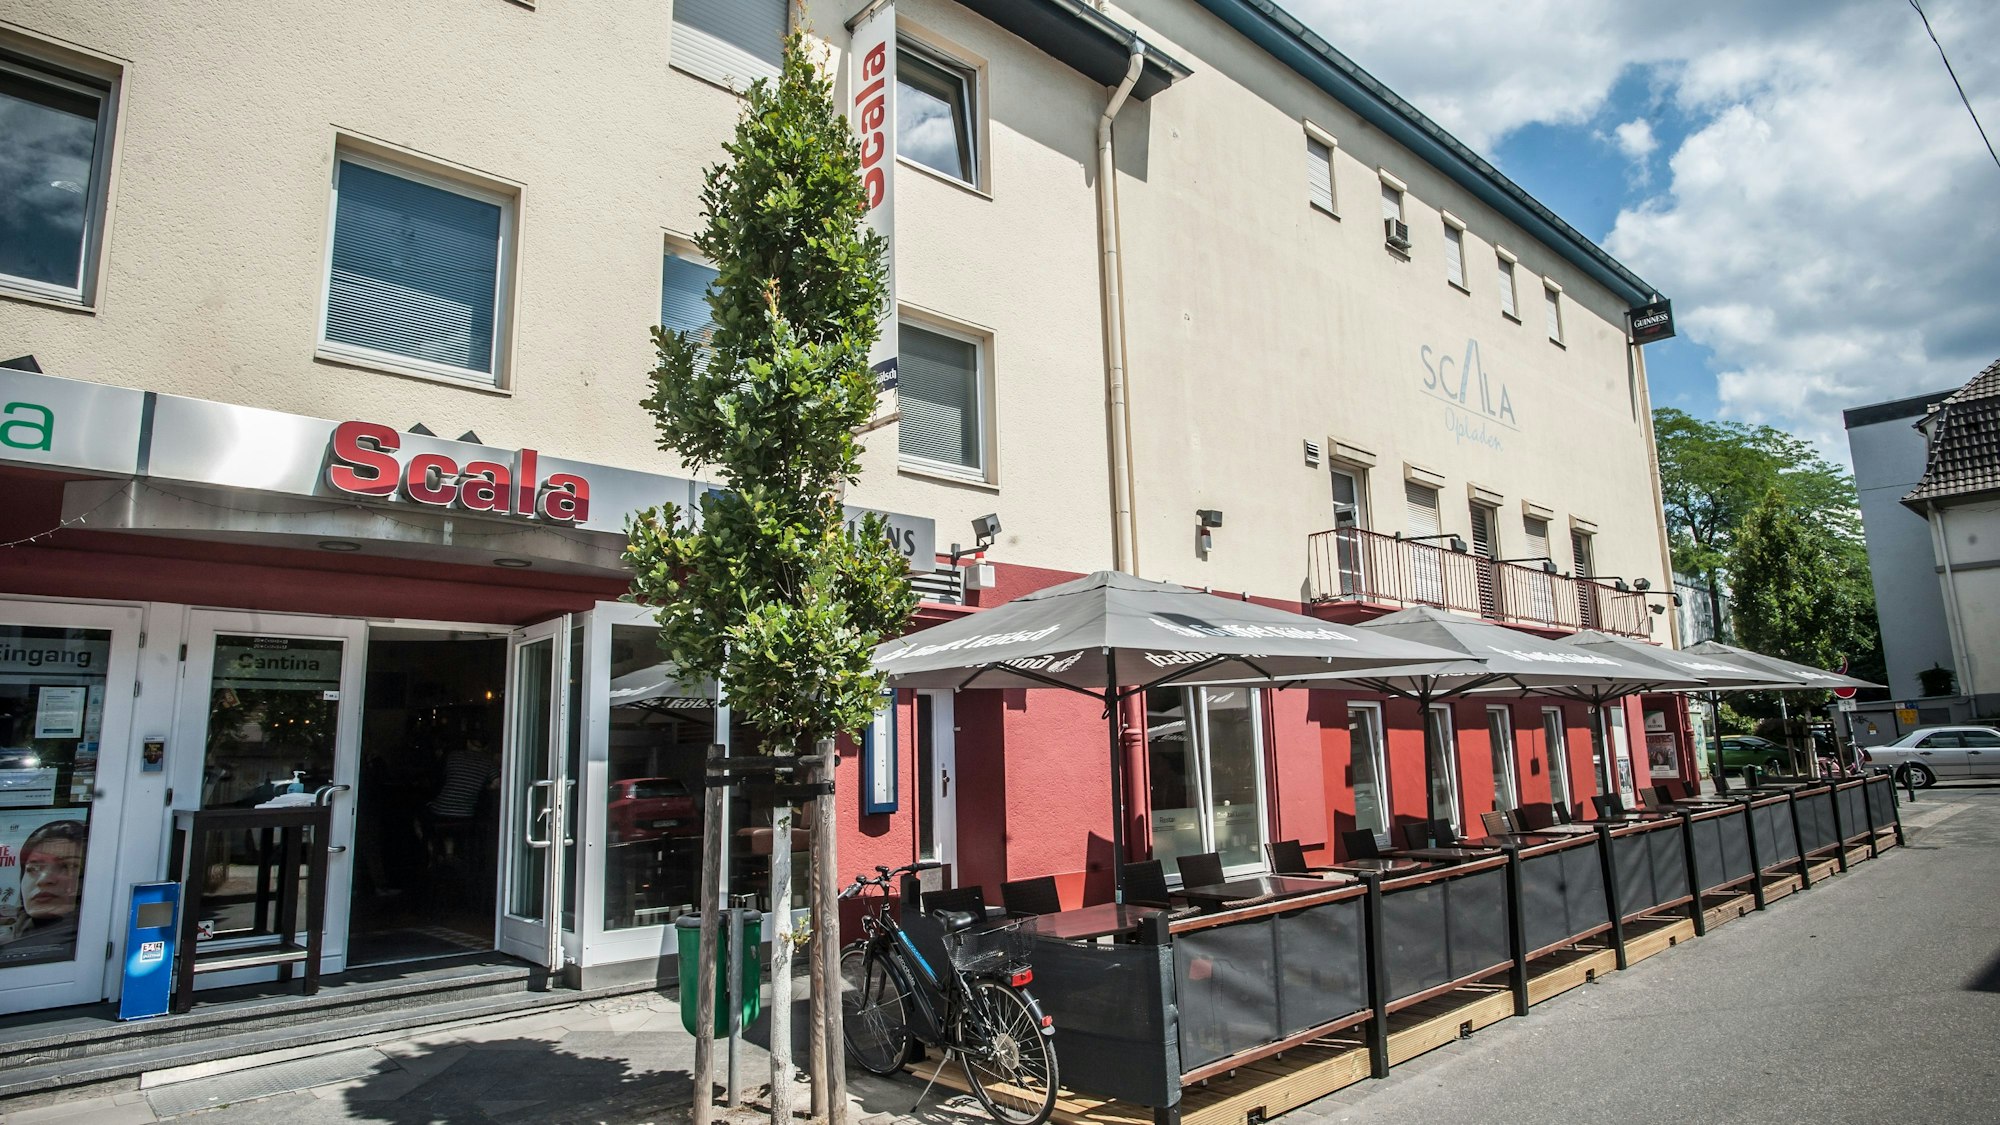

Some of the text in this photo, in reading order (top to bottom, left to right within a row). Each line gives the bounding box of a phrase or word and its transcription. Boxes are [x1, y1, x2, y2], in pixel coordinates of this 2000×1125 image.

[1633, 313, 1669, 328] GUINNESS
[1420, 338, 1516, 425] SCALA
[0, 400, 54, 451] a
[1445, 406, 1504, 452] Opladen
[325, 420, 592, 526] Scala
[0, 643, 92, 668] ingang
[238, 653, 320, 671] Cantina
